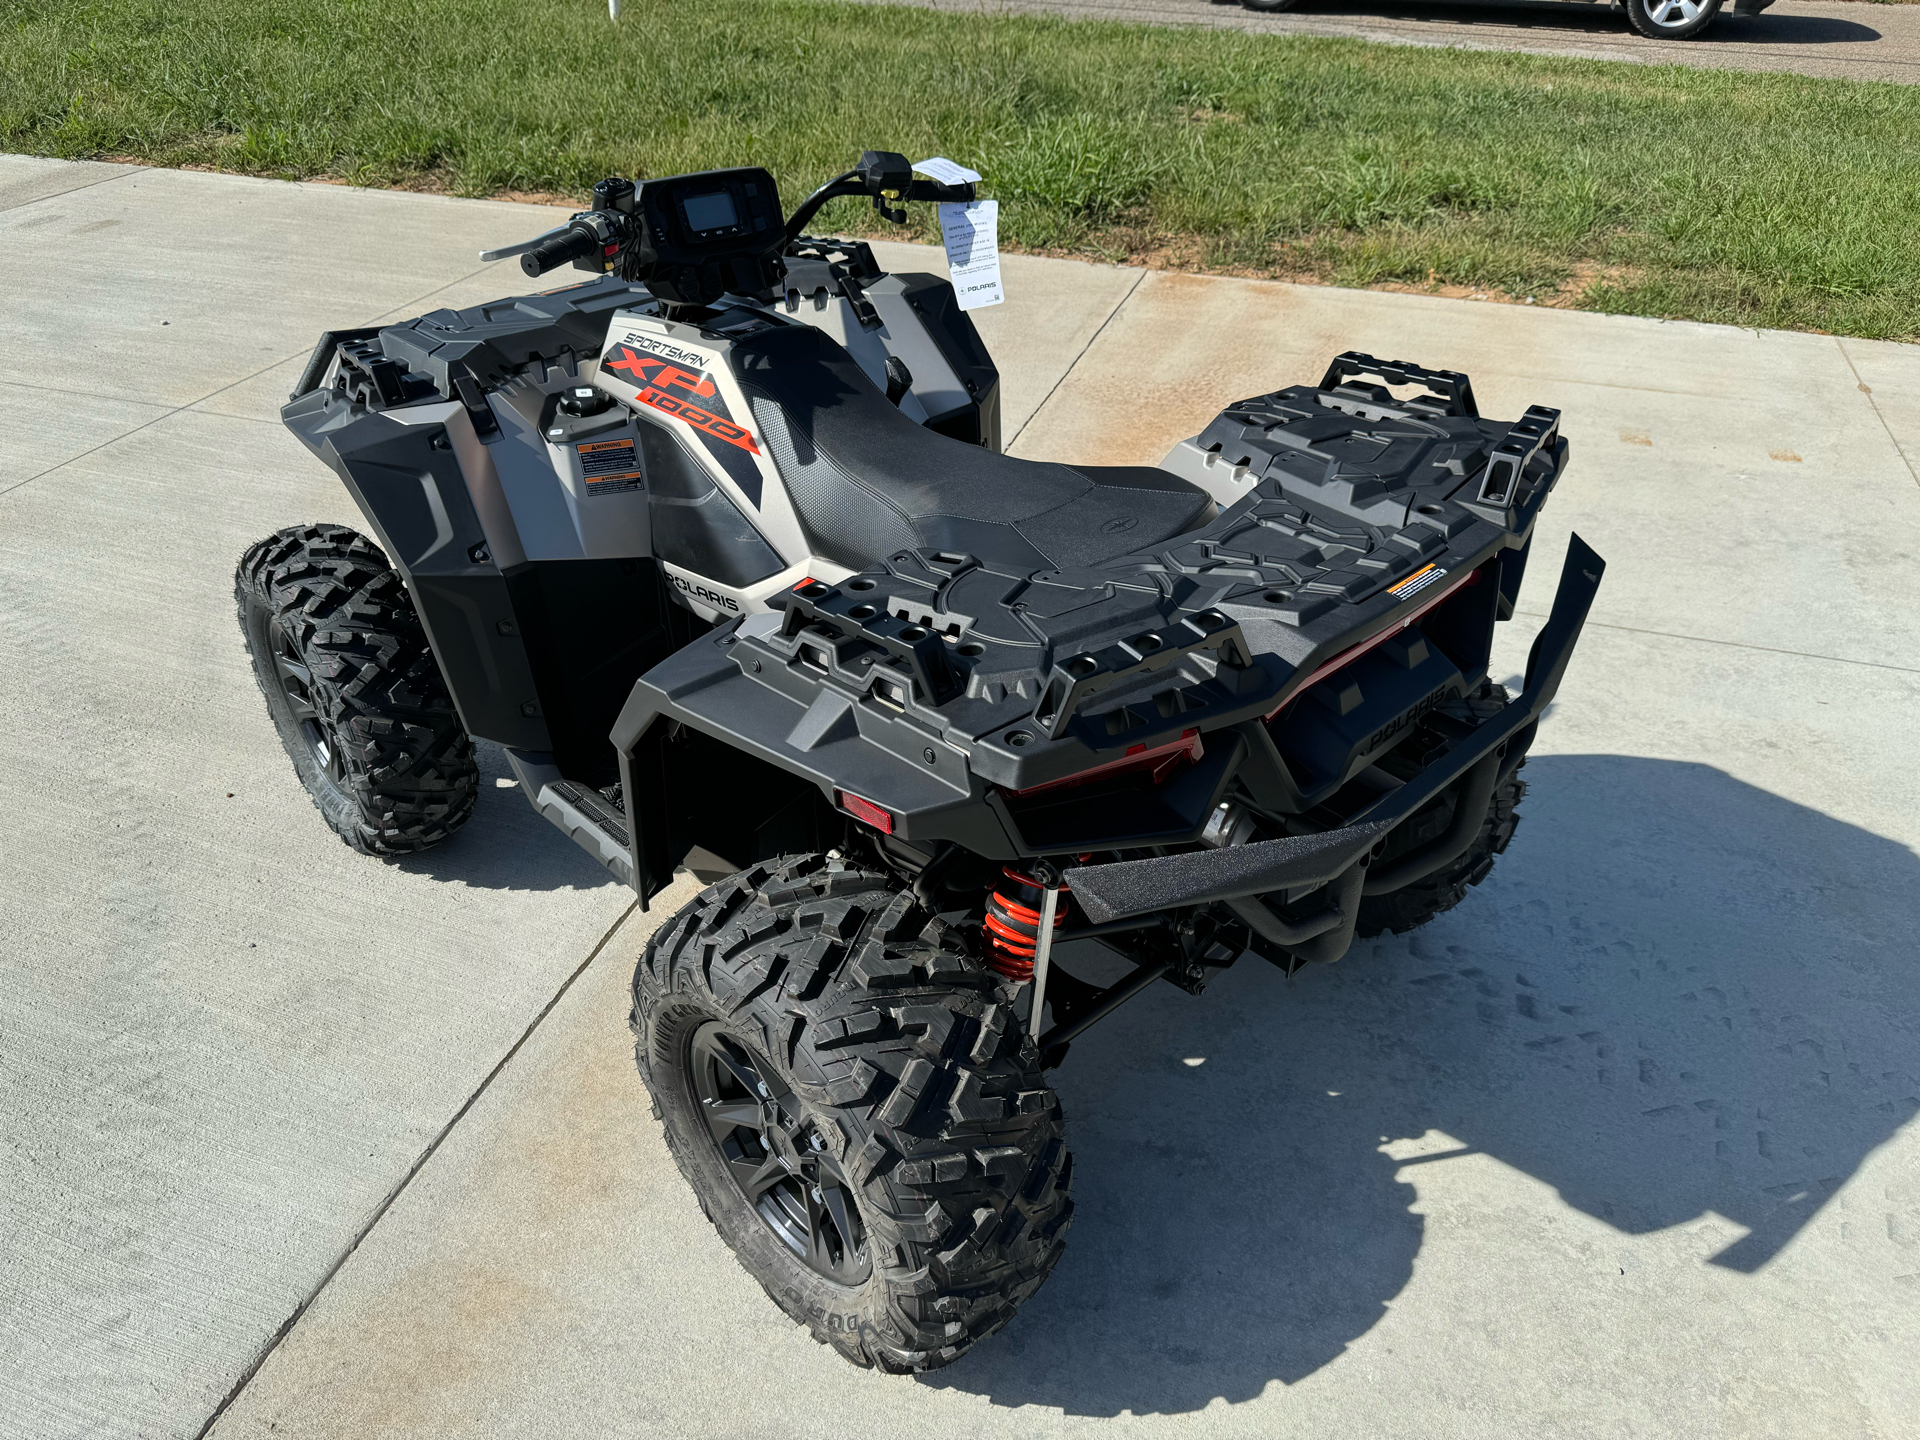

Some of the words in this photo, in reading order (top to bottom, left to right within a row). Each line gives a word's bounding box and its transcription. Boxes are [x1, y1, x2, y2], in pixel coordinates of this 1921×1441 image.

[967, 281, 997, 293] POLARIS
[623, 332, 710, 368] SPORTSMAN
[605, 347, 716, 398] XP
[647, 392, 747, 440] 1000
[596, 441, 622, 450] WARNING
[663, 571, 739, 612] POLARIS
[1369, 684, 1446, 752] POLARIS
[784, 1285, 860, 1332] DURO
